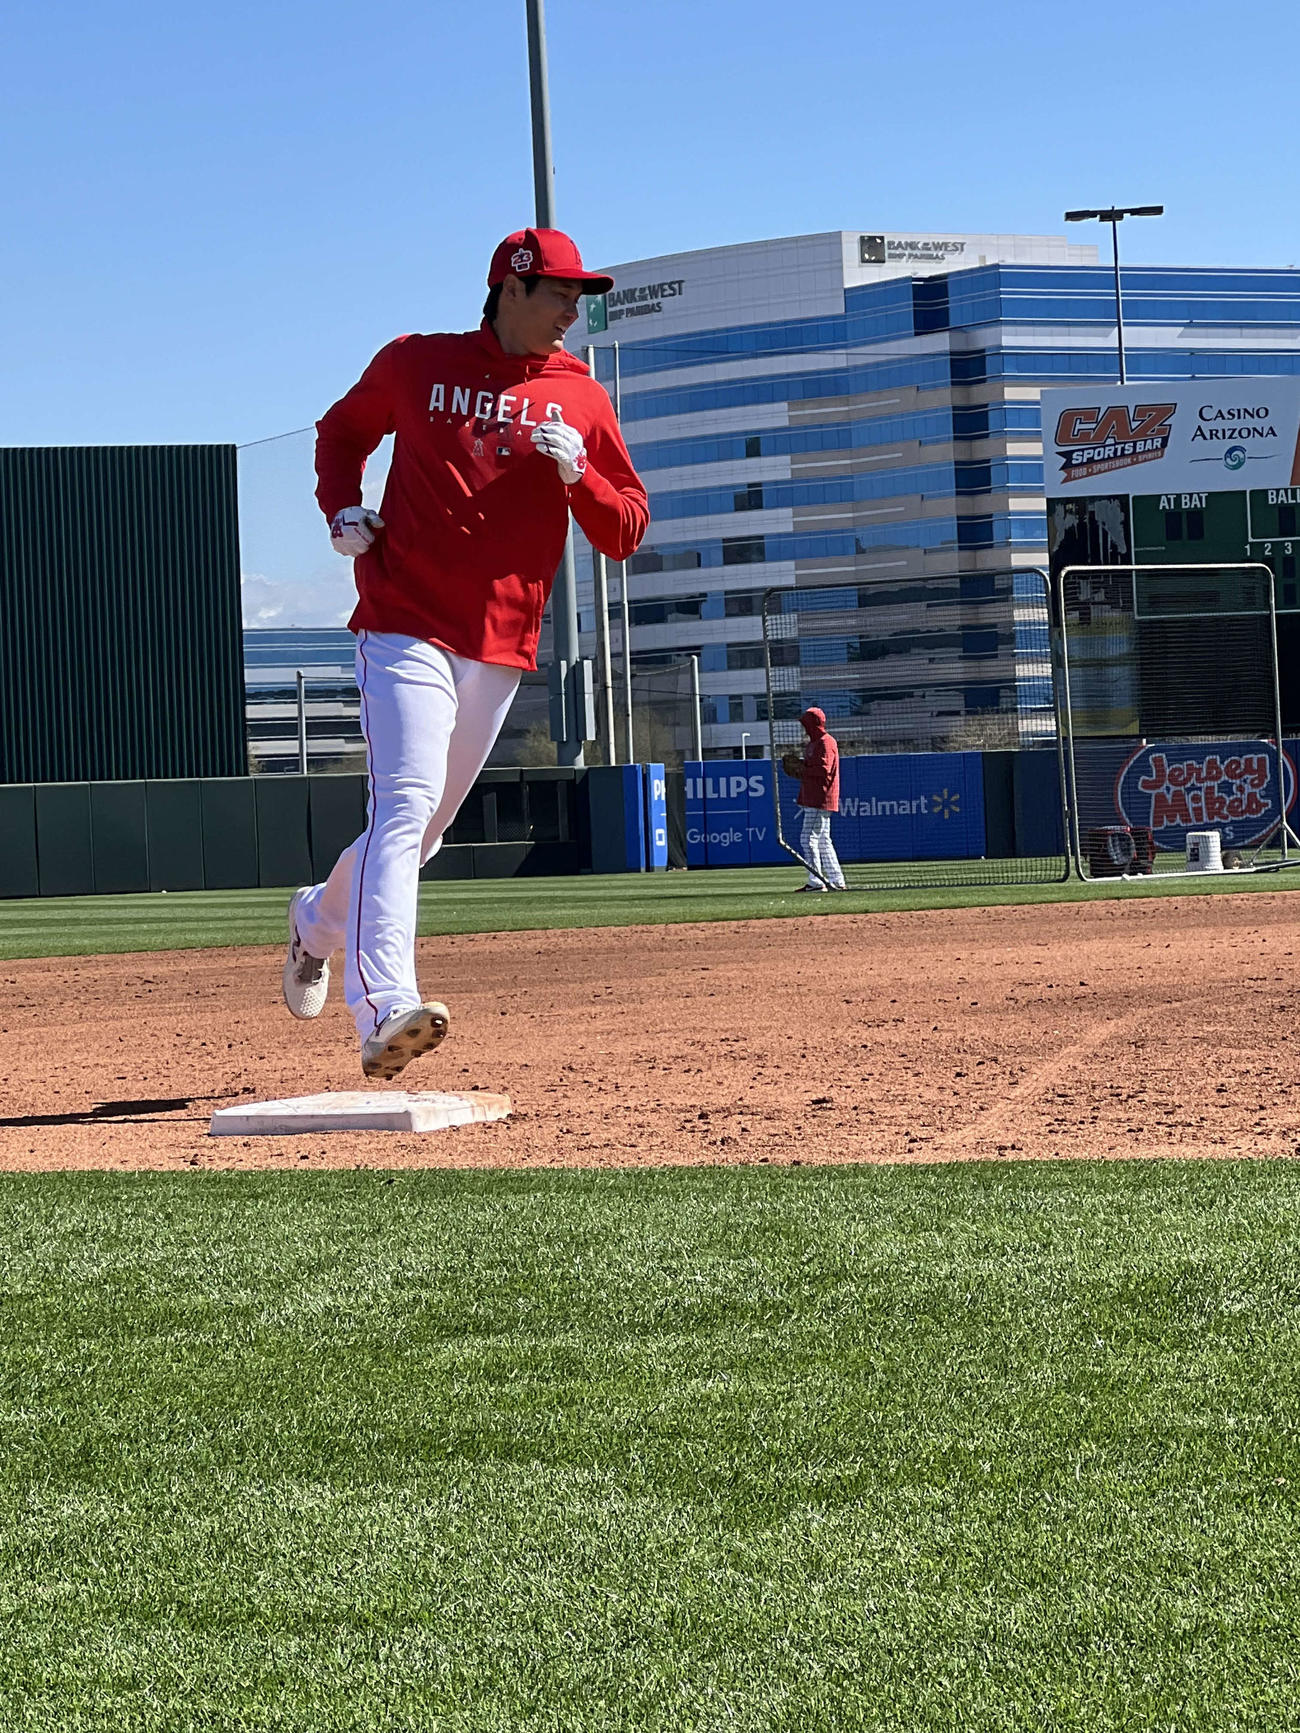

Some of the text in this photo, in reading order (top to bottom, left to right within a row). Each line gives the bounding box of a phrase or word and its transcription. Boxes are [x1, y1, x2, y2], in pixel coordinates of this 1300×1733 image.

[887, 240, 921, 251] BANK
[931, 241, 967, 252] WEST
[608, 287, 637, 307] BANK
[647, 280, 685, 299] WEST
[1055, 403, 1177, 446] CAZ
[1071, 438, 1162, 465] SPORTS BAR
[1159, 493, 1208, 510] AT BAT
[1245, 542, 1292, 556] 1 2 3
[1138, 753, 1271, 791] Jersey
[839, 797, 928, 817] Walmart
[1151, 784, 1272, 829] Mike's
[686, 827, 766, 846] Google TV
